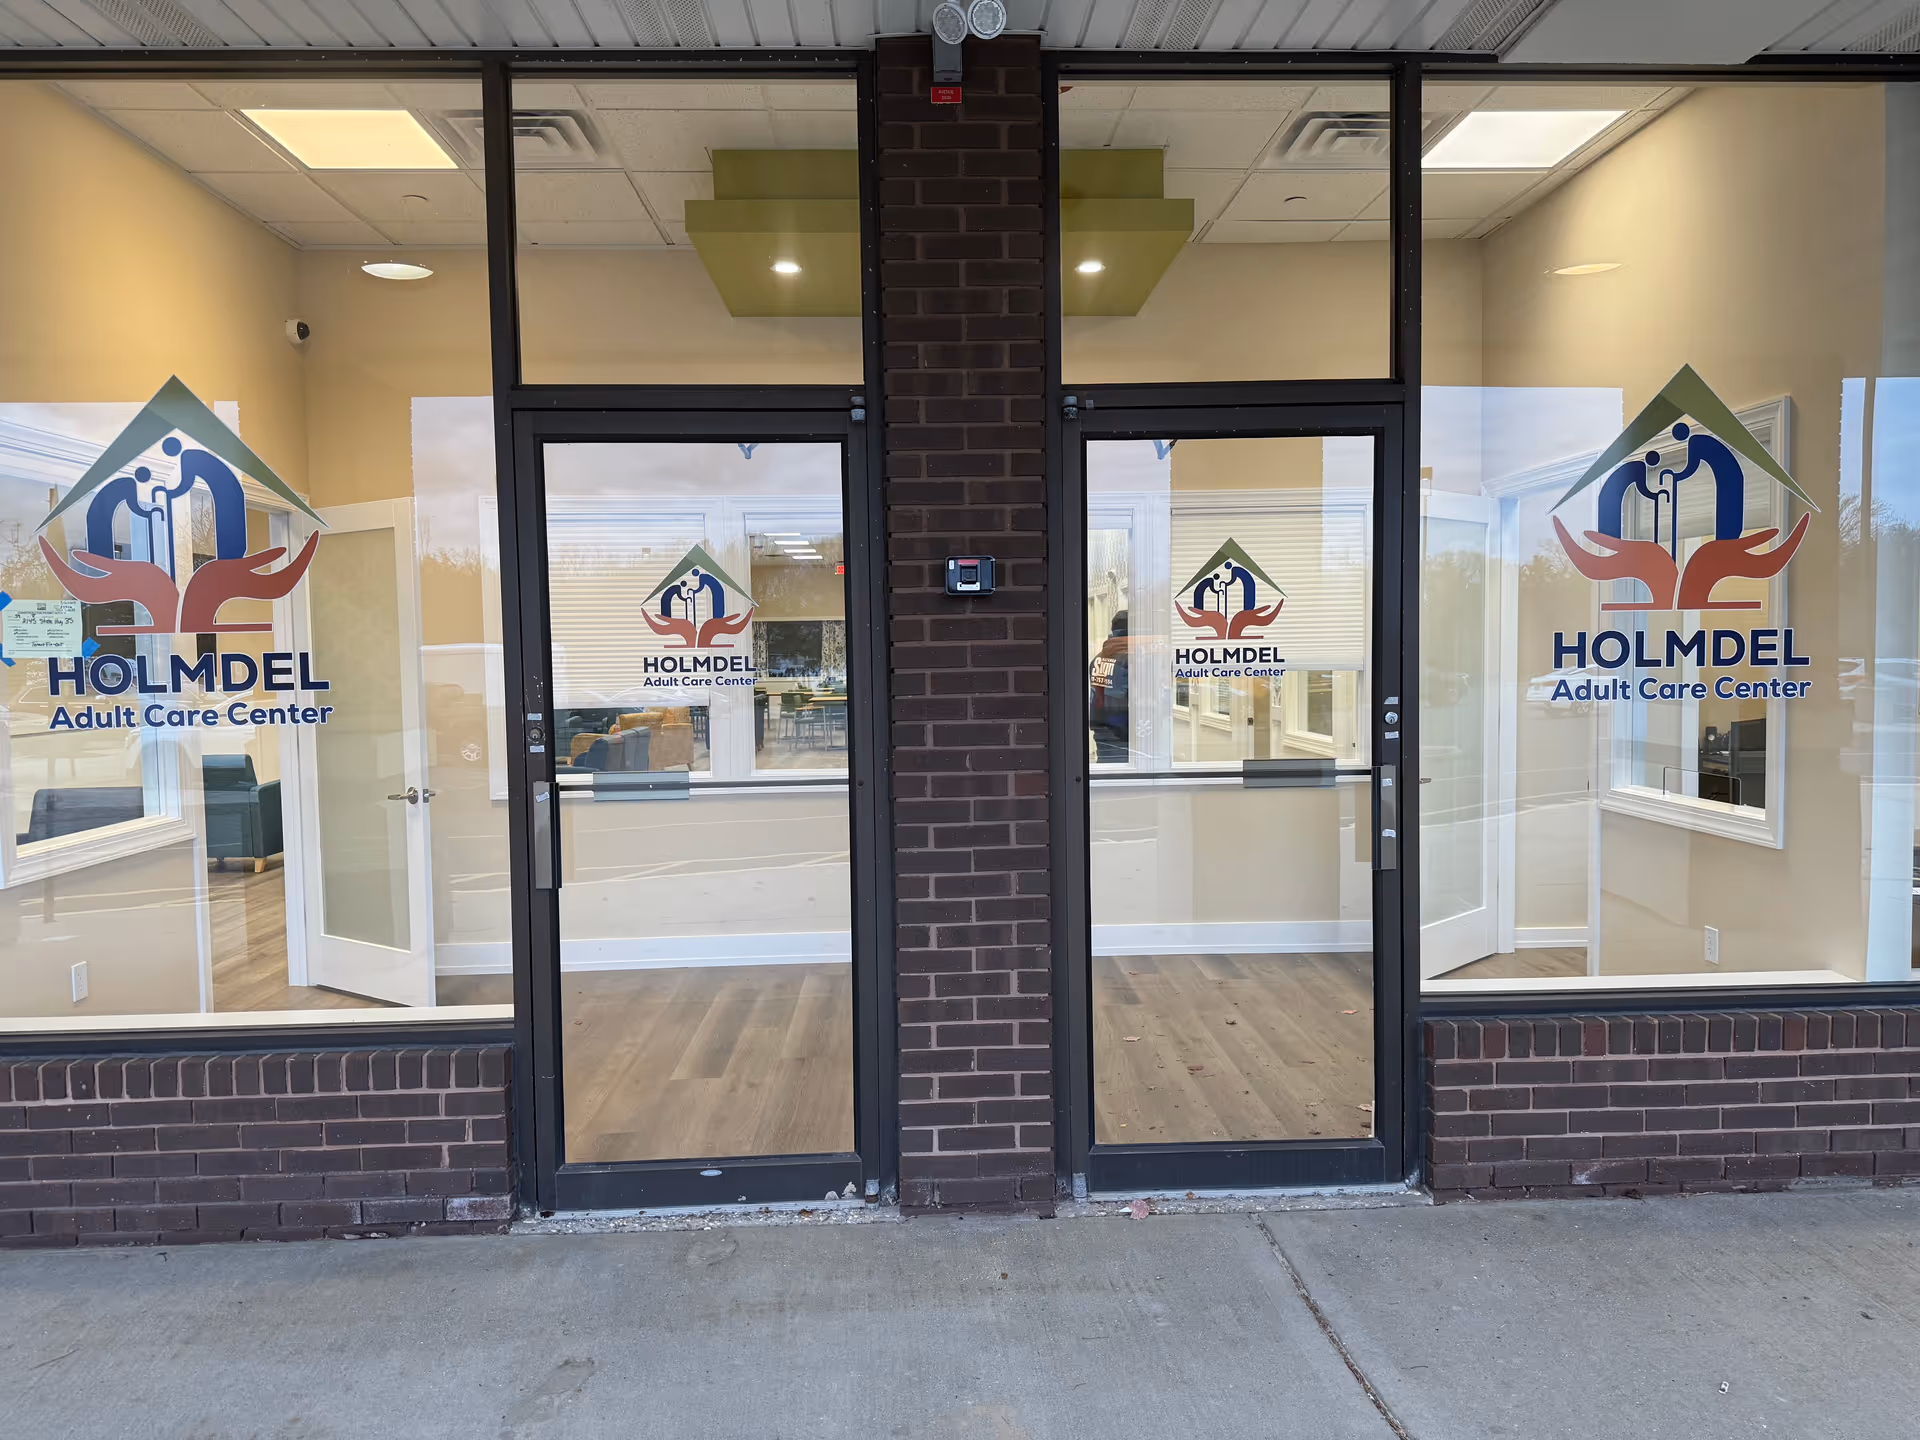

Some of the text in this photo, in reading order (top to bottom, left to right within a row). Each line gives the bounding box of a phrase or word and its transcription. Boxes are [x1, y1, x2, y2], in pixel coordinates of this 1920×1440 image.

[1174, 647, 1286, 665] HOLMDEL
[1551, 628, 1811, 669] HOLMDEL
[48, 652, 331, 696] HOLMDEL
[643, 655, 757, 674] HOLMDEL
[1174, 666, 1286, 678] Adult Care Center
[643, 675, 758, 687] Adult Care Center
[1550, 676, 1812, 702] Adult Care Center
[49, 702, 334, 730] Adult Care Center
